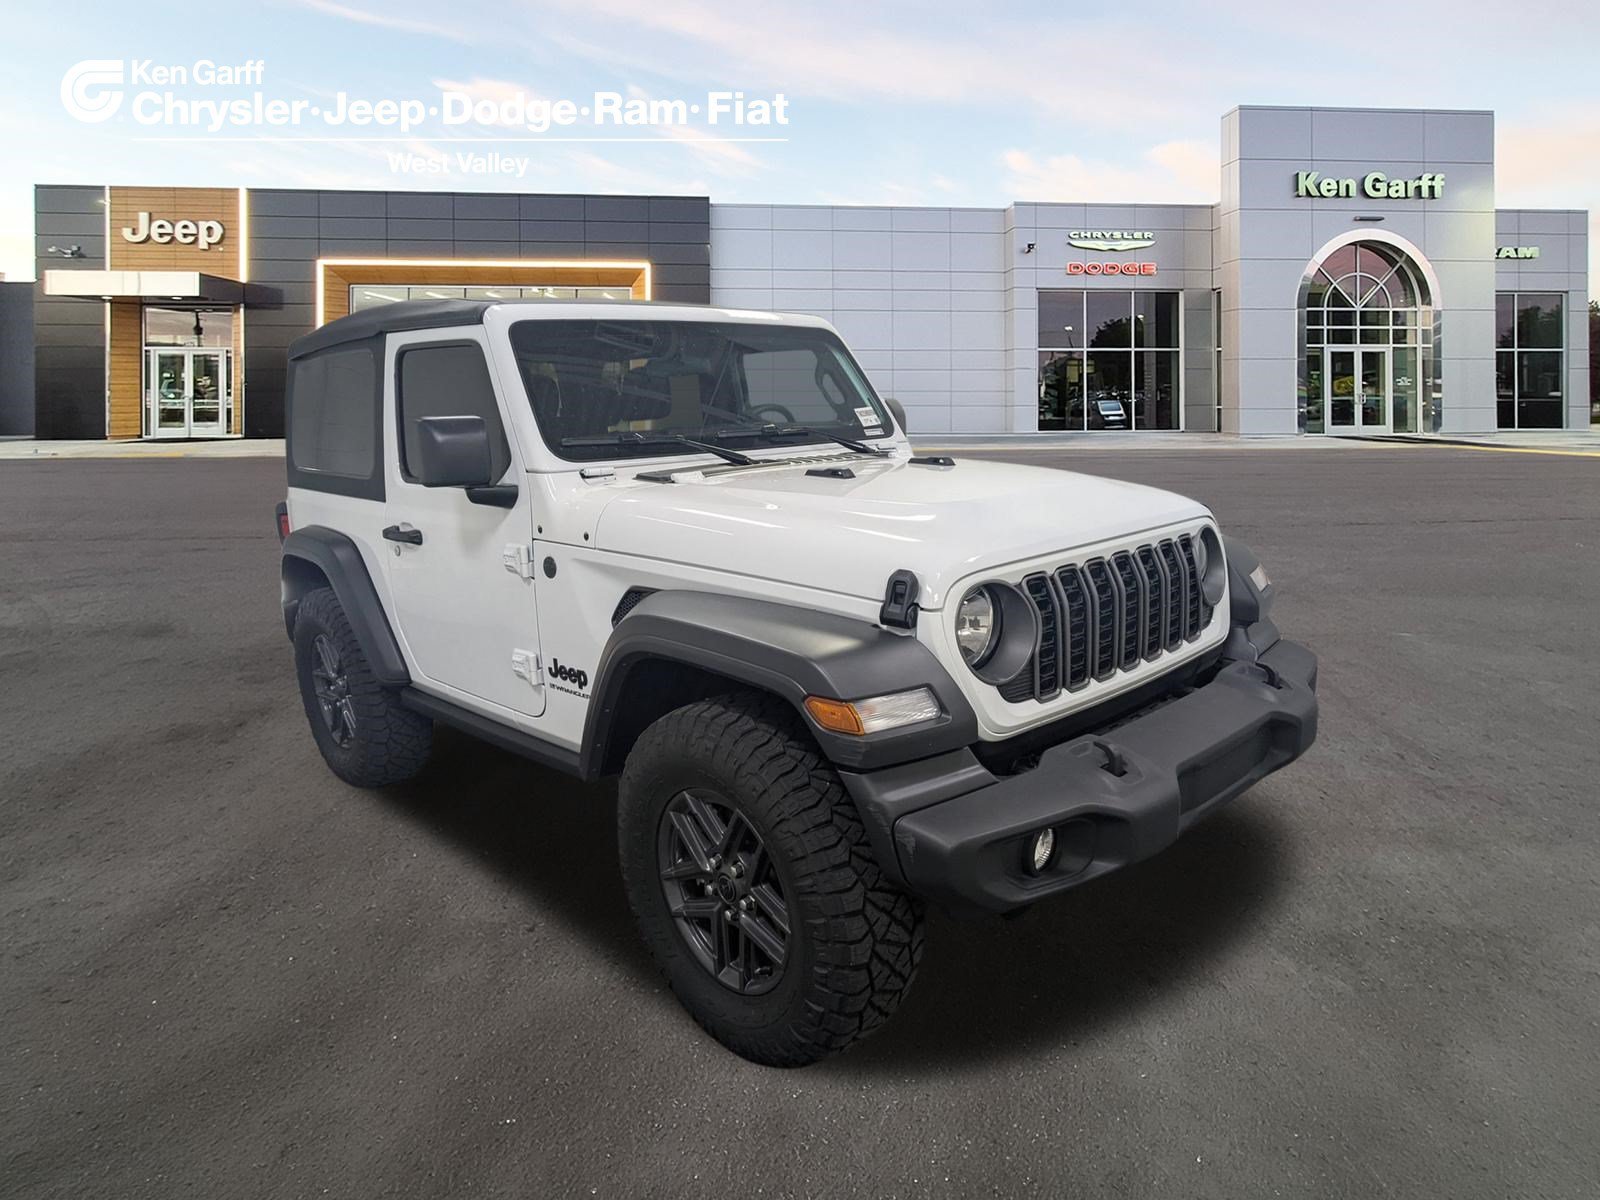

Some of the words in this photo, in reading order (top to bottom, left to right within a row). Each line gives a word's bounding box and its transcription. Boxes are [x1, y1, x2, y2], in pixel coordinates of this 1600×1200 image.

[1296, 170, 1357, 197] Ken
[1362, 171, 1446, 199] Garff
[121, 211, 225, 250] Jeep
[1068, 231, 1154, 239] CHRYSLER
[1495, 246, 1540, 259] AM
[1066, 261, 1158, 275] DODGE
[547, 657, 589, 690] Jeep
